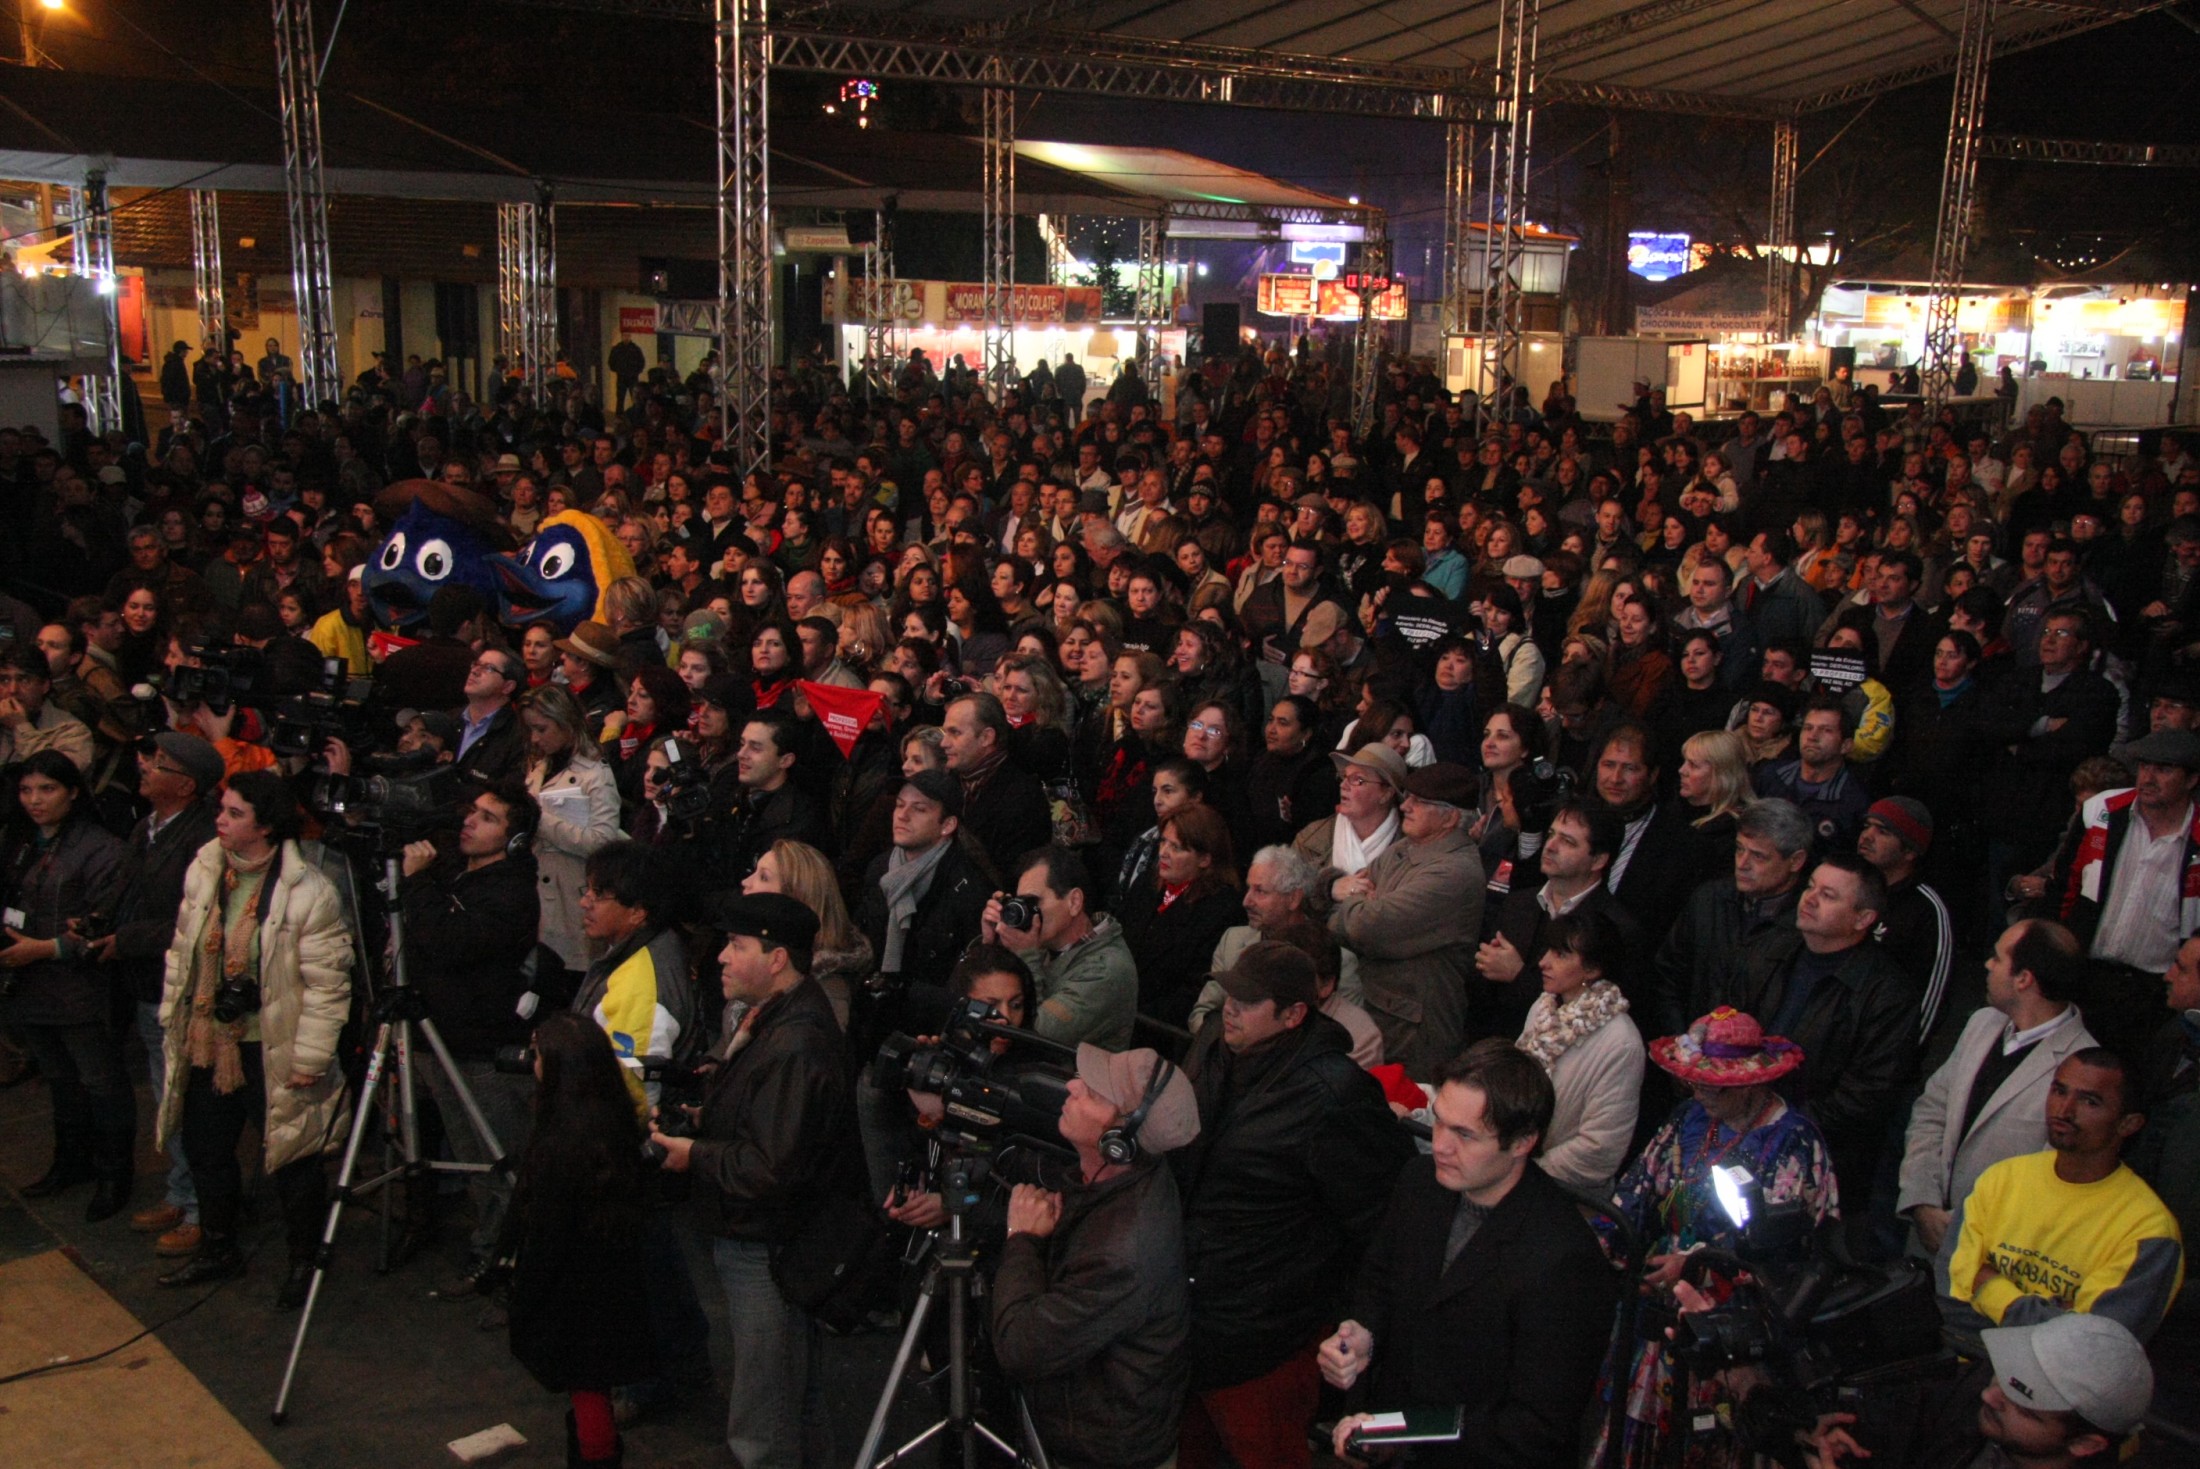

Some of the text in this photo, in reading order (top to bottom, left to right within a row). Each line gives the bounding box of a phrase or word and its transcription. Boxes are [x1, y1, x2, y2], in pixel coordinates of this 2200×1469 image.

[1640, 319, 1703, 329] CHOCONHAQUE
[1710, 320, 1762, 330] CHOCOLATE
[1819, 669, 1865, 681] PROFESSOR
